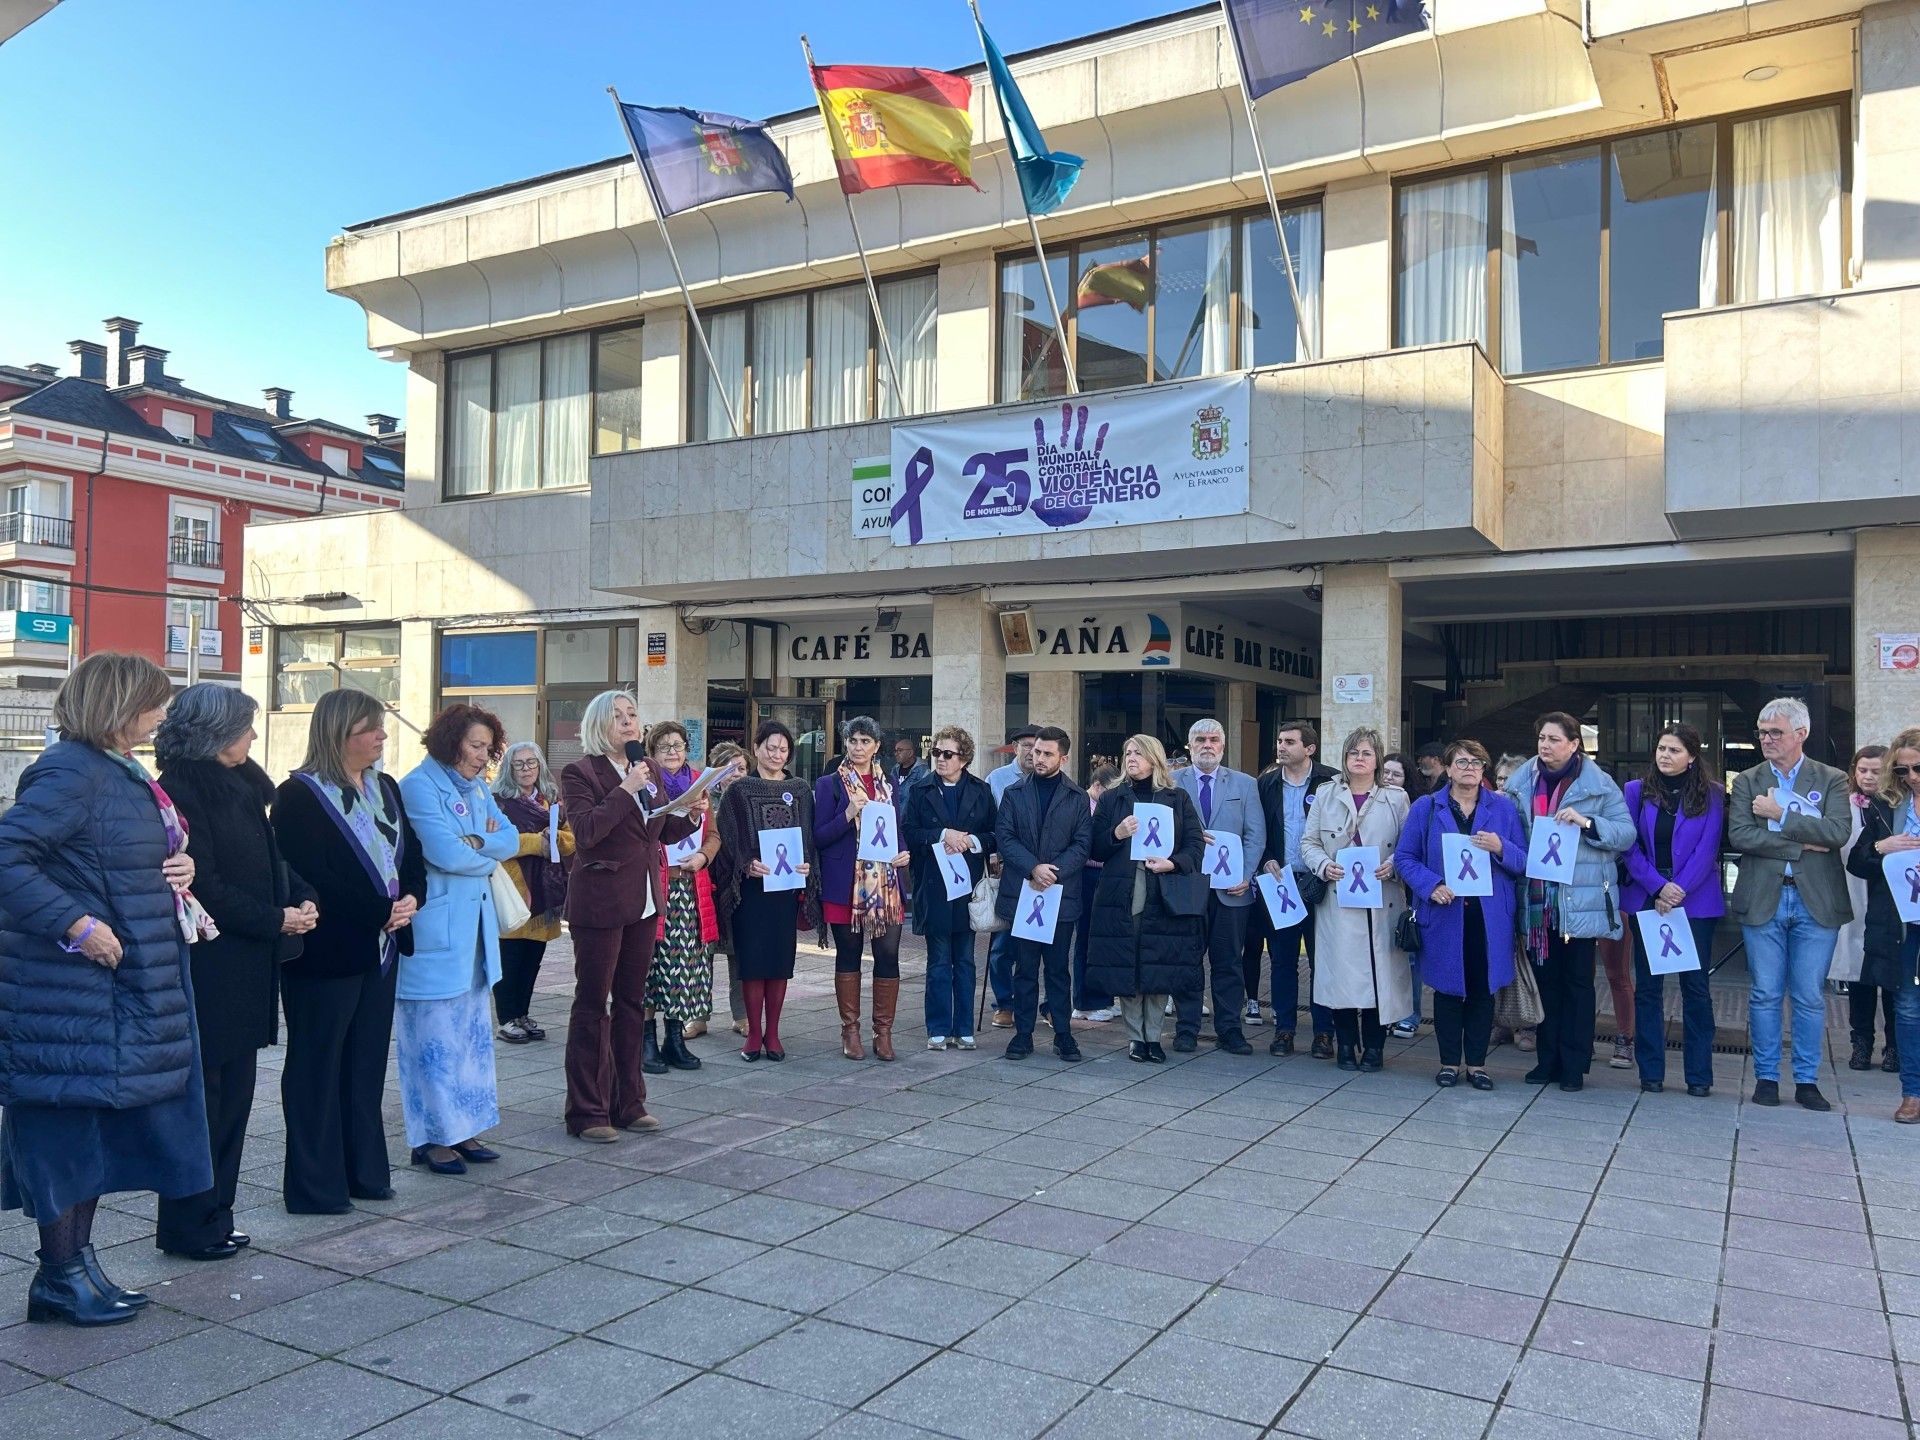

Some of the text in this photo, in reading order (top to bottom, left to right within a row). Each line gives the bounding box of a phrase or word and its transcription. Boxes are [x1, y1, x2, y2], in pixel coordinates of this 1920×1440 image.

[1037, 443, 1058, 456] DÍA
[1038, 450, 1095, 467] MUNDIAL
[1039, 459, 1111, 477] CONTRA LA
[962, 448, 1032, 519] 25
[1039, 464, 1159, 494] VIOLENCIA
[965, 504, 1023, 518] DE NOVIEMBRE
[1045, 496, 1066, 509] DE
[791, 626, 871, 661] CAFÉ
[1185, 624, 1314, 680] CAFÉ BAR ESPAÑA
